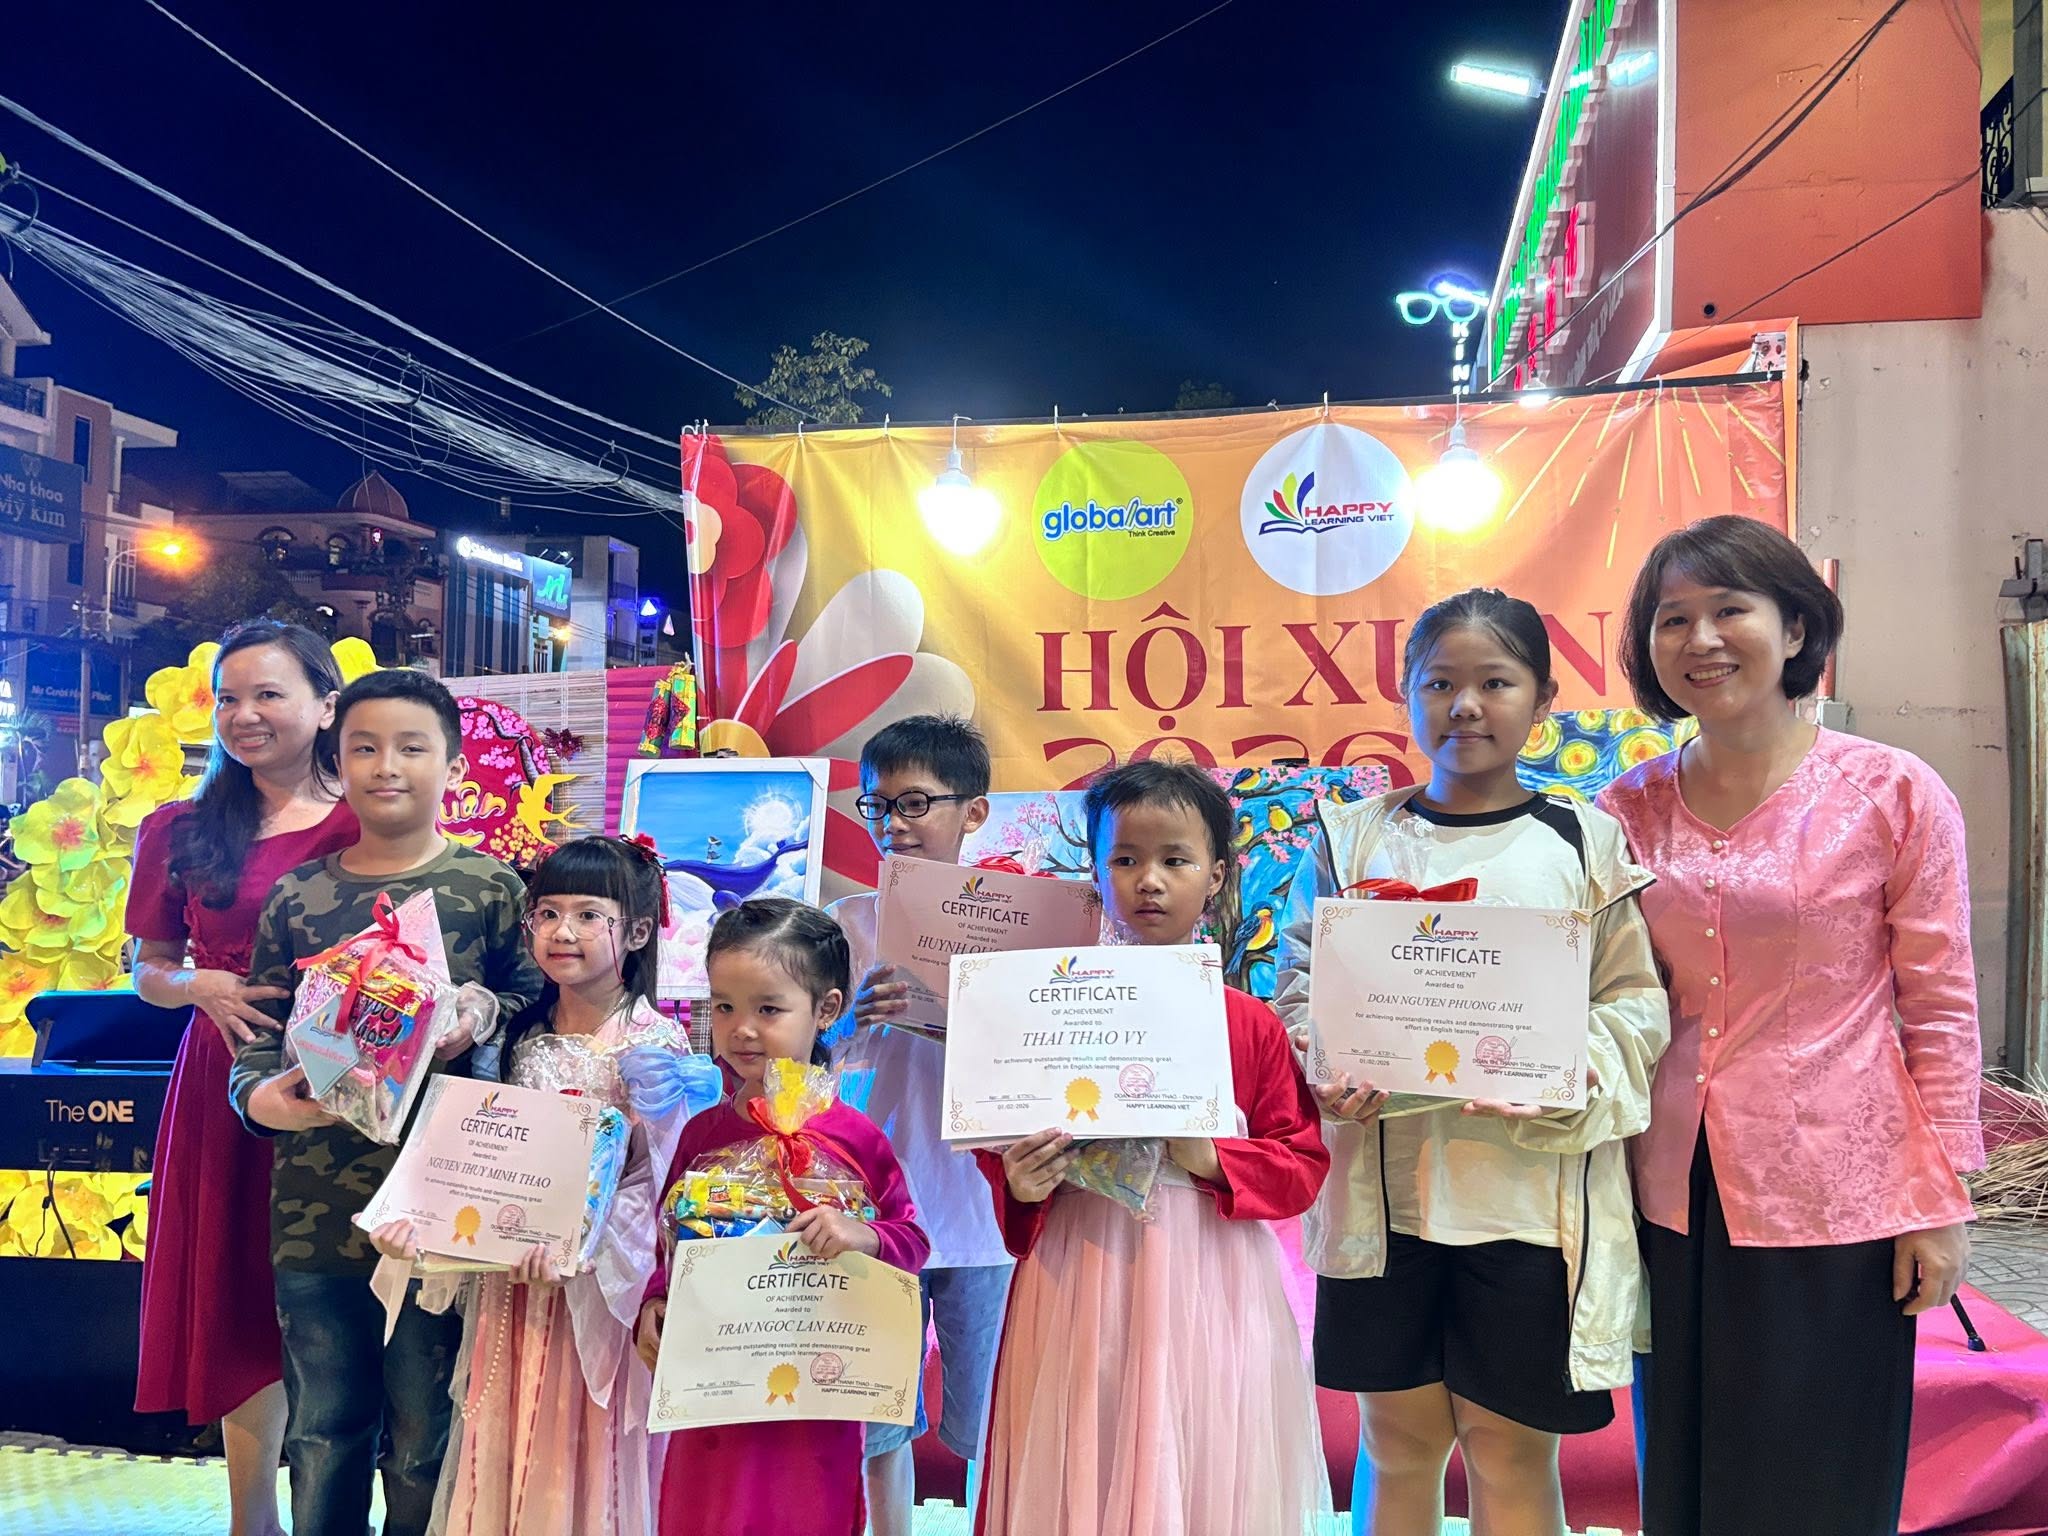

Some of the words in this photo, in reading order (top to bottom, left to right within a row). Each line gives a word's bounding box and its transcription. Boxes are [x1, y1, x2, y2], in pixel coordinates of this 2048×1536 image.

[30, 479, 64, 503] khoa
[1304, 501, 1394, 518] HAPPY
[1304, 515, 1365, 526] LEARNING
[1368, 513, 1395, 524] VIET
[1128, 530, 1146, 539] Think
[1147, 529, 1176, 538] Creative
[1035, 601, 1253, 731] HỘI
[977, 890, 1012, 900] HAPPY
[941, 900, 1030, 926] CERTIFICATE
[966, 924, 1008, 935] ACHIEVEMENT
[1434, 929, 1479, 937] HAPPY
[966, 934, 990, 943] Awarded
[917, 936, 967, 955] HUYNH
[1391, 944, 1502, 966] CERTIFICATE
[1413, 968, 1424, 976] OF
[1425, 969, 1477, 978] ACHIEVEMENT
[1424, 981, 1455, 989] Awarded
[1029, 986, 1138, 1003] CERTIFICATE
[1367, 993, 1400, 1004] DOAN
[1400, 995, 1447, 1008] NGUYEN
[1447, 998, 1497, 1012] PHUONG
[1498, 1002, 1524, 1014] ANH
[1051, 1008, 1062, 1016] OF
[1063, 1007, 1114, 1016] ACHIEVEMENT
[1365, 1013, 1394, 1022] achieving
[1395, 1015, 1432, 1025] outstanding
[1433, 1018, 1454, 1026] results
[1468, 1020, 1514, 1030] demonstrating
[1515, 1024, 1532, 1032] great
[1430, 1026, 1453, 1034] English
[1454, 1027, 1480, 1036] learning
[1022, 1031, 1064, 1047] THAI
[1065, 1030, 1119, 1045] THAO
[1124, 1030, 1148, 1045] VY
[1004, 1056, 1033, 1065] achieving
[1034, 1055, 1071, 1063] outstanding
[1108, 1055, 1154, 1063] demonstrating
[1155, 1056, 1172, 1064] great
[1070, 1063, 1093, 1071] English
[1094, 1063, 1120, 1071] learning
[1504, 1070, 1534, 1078] LEARNING
[460, 1117, 530, 1142] CERTIFICATE
[468, 1139, 476, 1147] OF
[475, 1141, 508, 1152] ACHIEVEMENT
[472, 1151, 492, 1160] Awarded
[426, 1156, 462, 1172] NGUYEN
[460, 1162, 489, 1177] THUY
[487, 1167, 519, 1183] MINH
[519, 1173, 552, 1189] THAO
[493, 1189, 528, 1202] demonstrating
[747, 1272, 850, 1291] CERTIFICATE
[765, 1295, 776, 1303] OF
[775, 1294, 824, 1303] ACHIEVEMENT
[716, 1321, 753, 1336] TRAN
[752, 1320, 795, 1334] NGOC
[796, 1320, 826, 1332] LAN
[826, 1321, 869, 1337] KHUE
[714, 1344, 742, 1353] achieving
[742, 1342, 778, 1350] outstanding
[811, 1342, 854, 1352] demonstrating
[854, 1346, 872, 1354] great
[797, 1350, 822, 1358] learning
[840, 1388, 868, 1396] LEARNING
